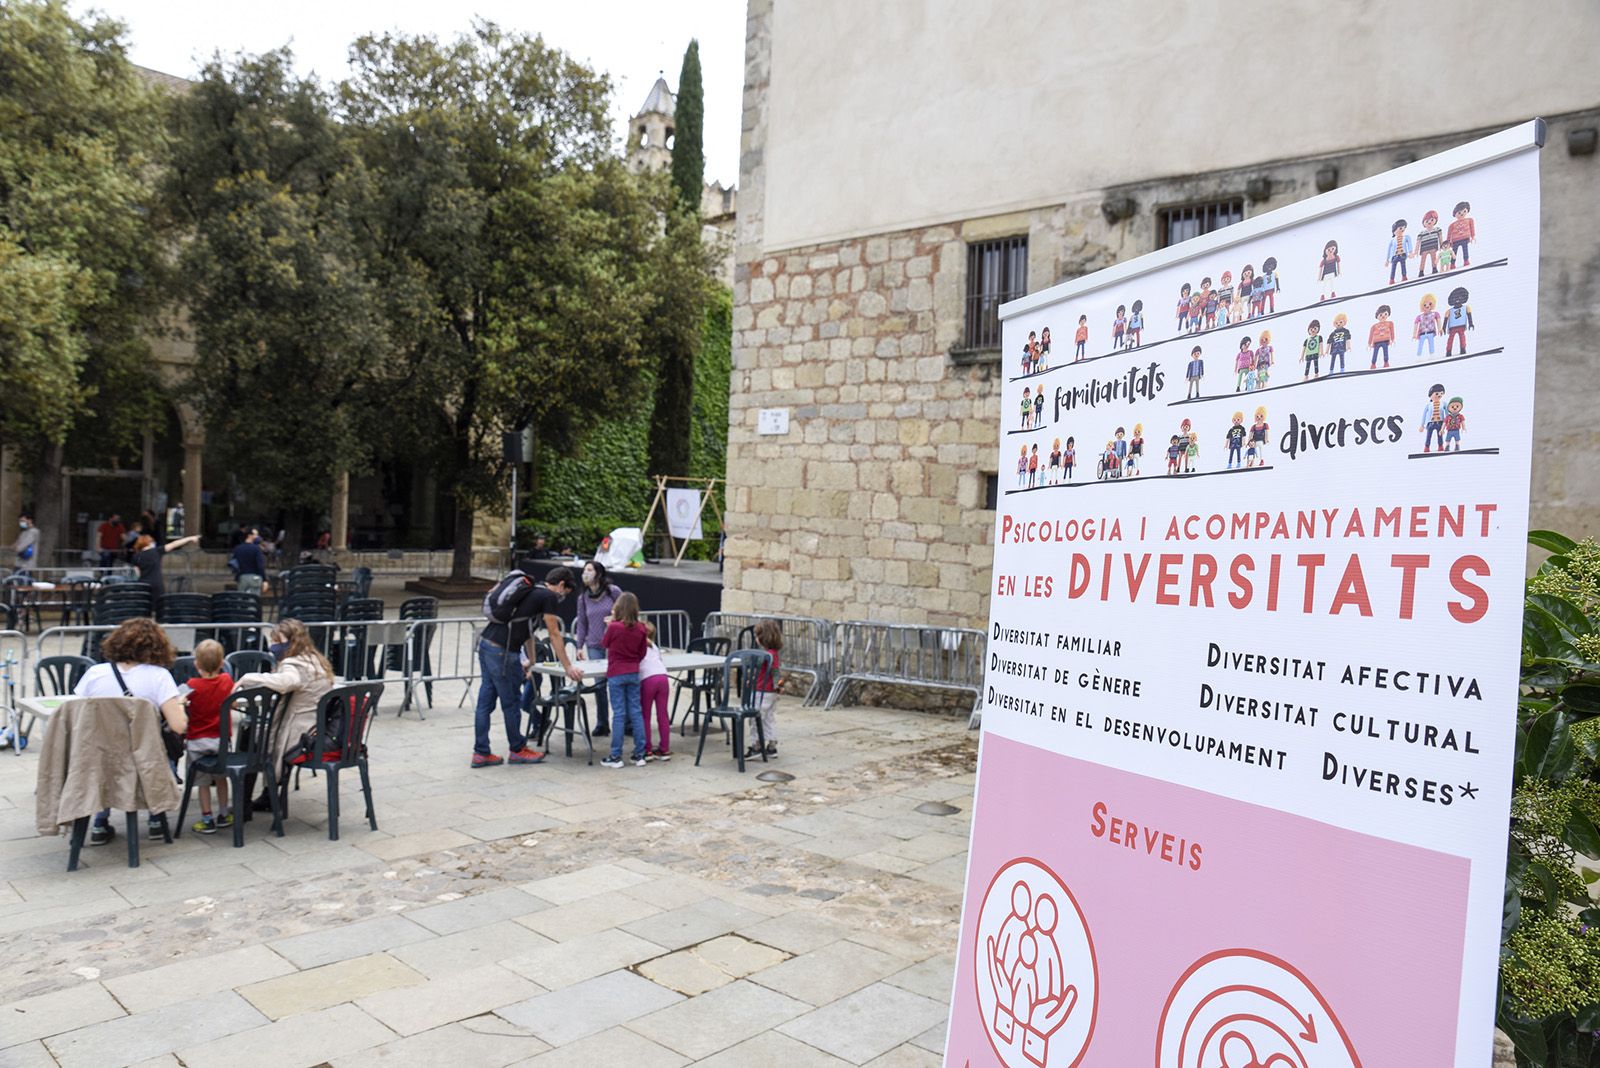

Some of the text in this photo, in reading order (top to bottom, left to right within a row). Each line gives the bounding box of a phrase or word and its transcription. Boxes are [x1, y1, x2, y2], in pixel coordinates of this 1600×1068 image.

[1054, 363, 1165, 423] familiaritats
[1280, 413, 1404, 461] diverses
[1001, 504, 1497, 543] PSICOLOGIA I ACOMPANYAMENT
[997, 553, 1491, 624] EN LES DIVERSITATS
[993, 621, 1122, 657] DIVERSITAT FAMILIAR
[991, 652, 1142, 698] DIVERSITAT DE GÈNERE
[1207, 642, 1483, 701] DIVERSITAT AFECTIVA
[988, 685, 1287, 771] DIVERSITAT EN EL DESENVOLUPAMENT
[1199, 683, 1480, 755] DIVERSITAT CULTURAL
[1090, 801, 1203, 872] SERVEIS
